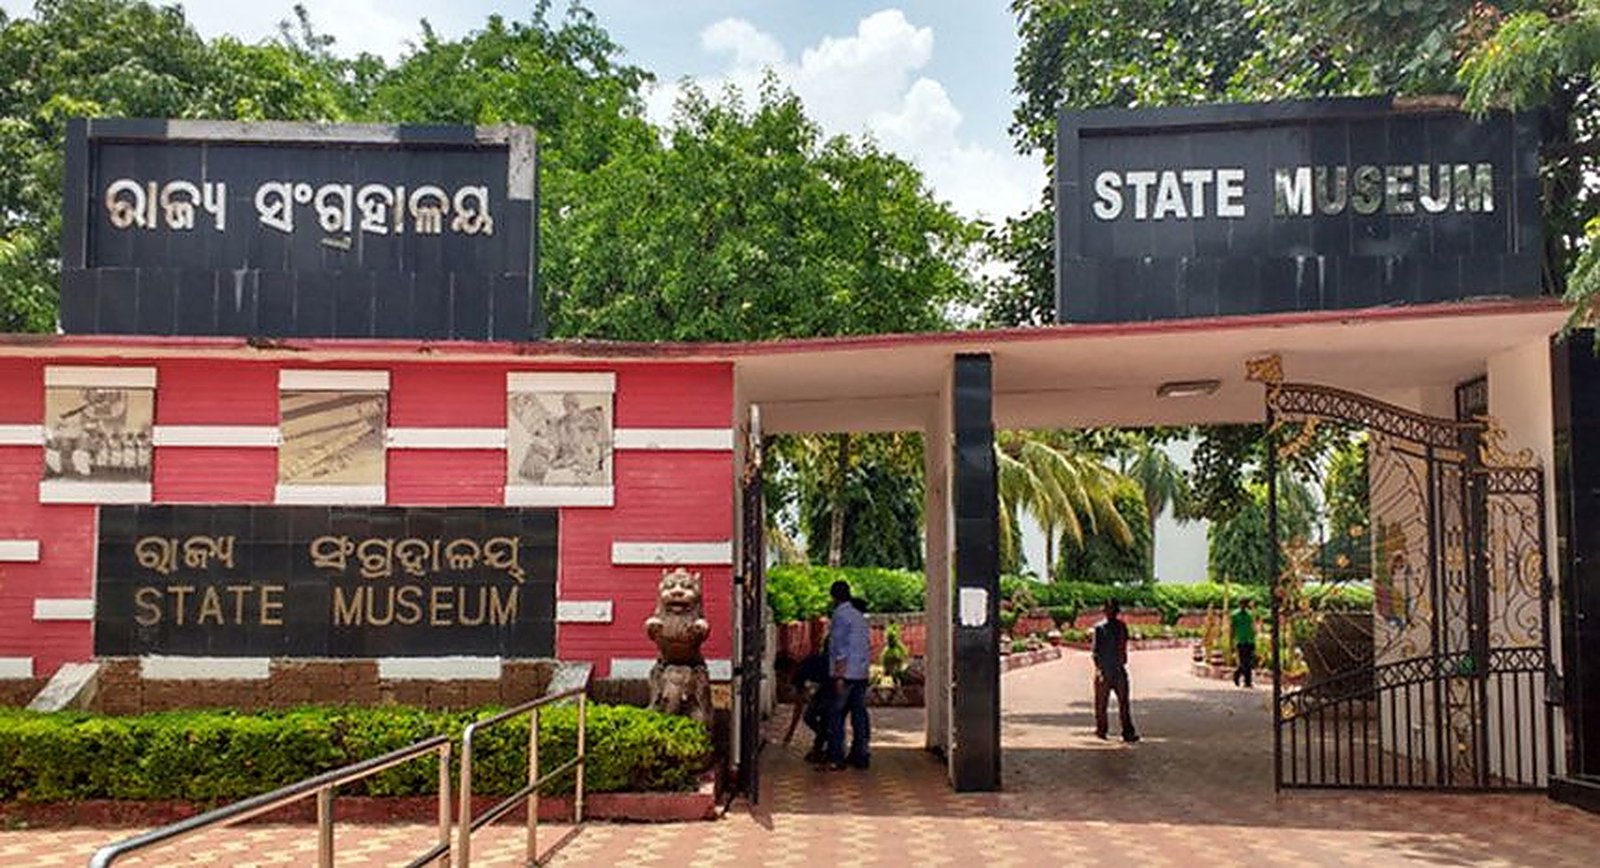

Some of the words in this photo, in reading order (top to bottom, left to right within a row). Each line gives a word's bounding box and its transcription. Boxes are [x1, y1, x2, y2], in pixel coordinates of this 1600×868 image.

[106, 178, 226, 231] ରାଜ୍ୟ
[255, 181, 494, 250] ସଂଗ୍ରହାଳୟ
[1093, 168, 1245, 220] STATE
[1274, 163, 1494, 218] MUSEUM
[134, 535, 236, 574] ରାଜ୍ୟ
[134, 585, 284, 626] STATE
[333, 585, 520, 626] MUSEUM
